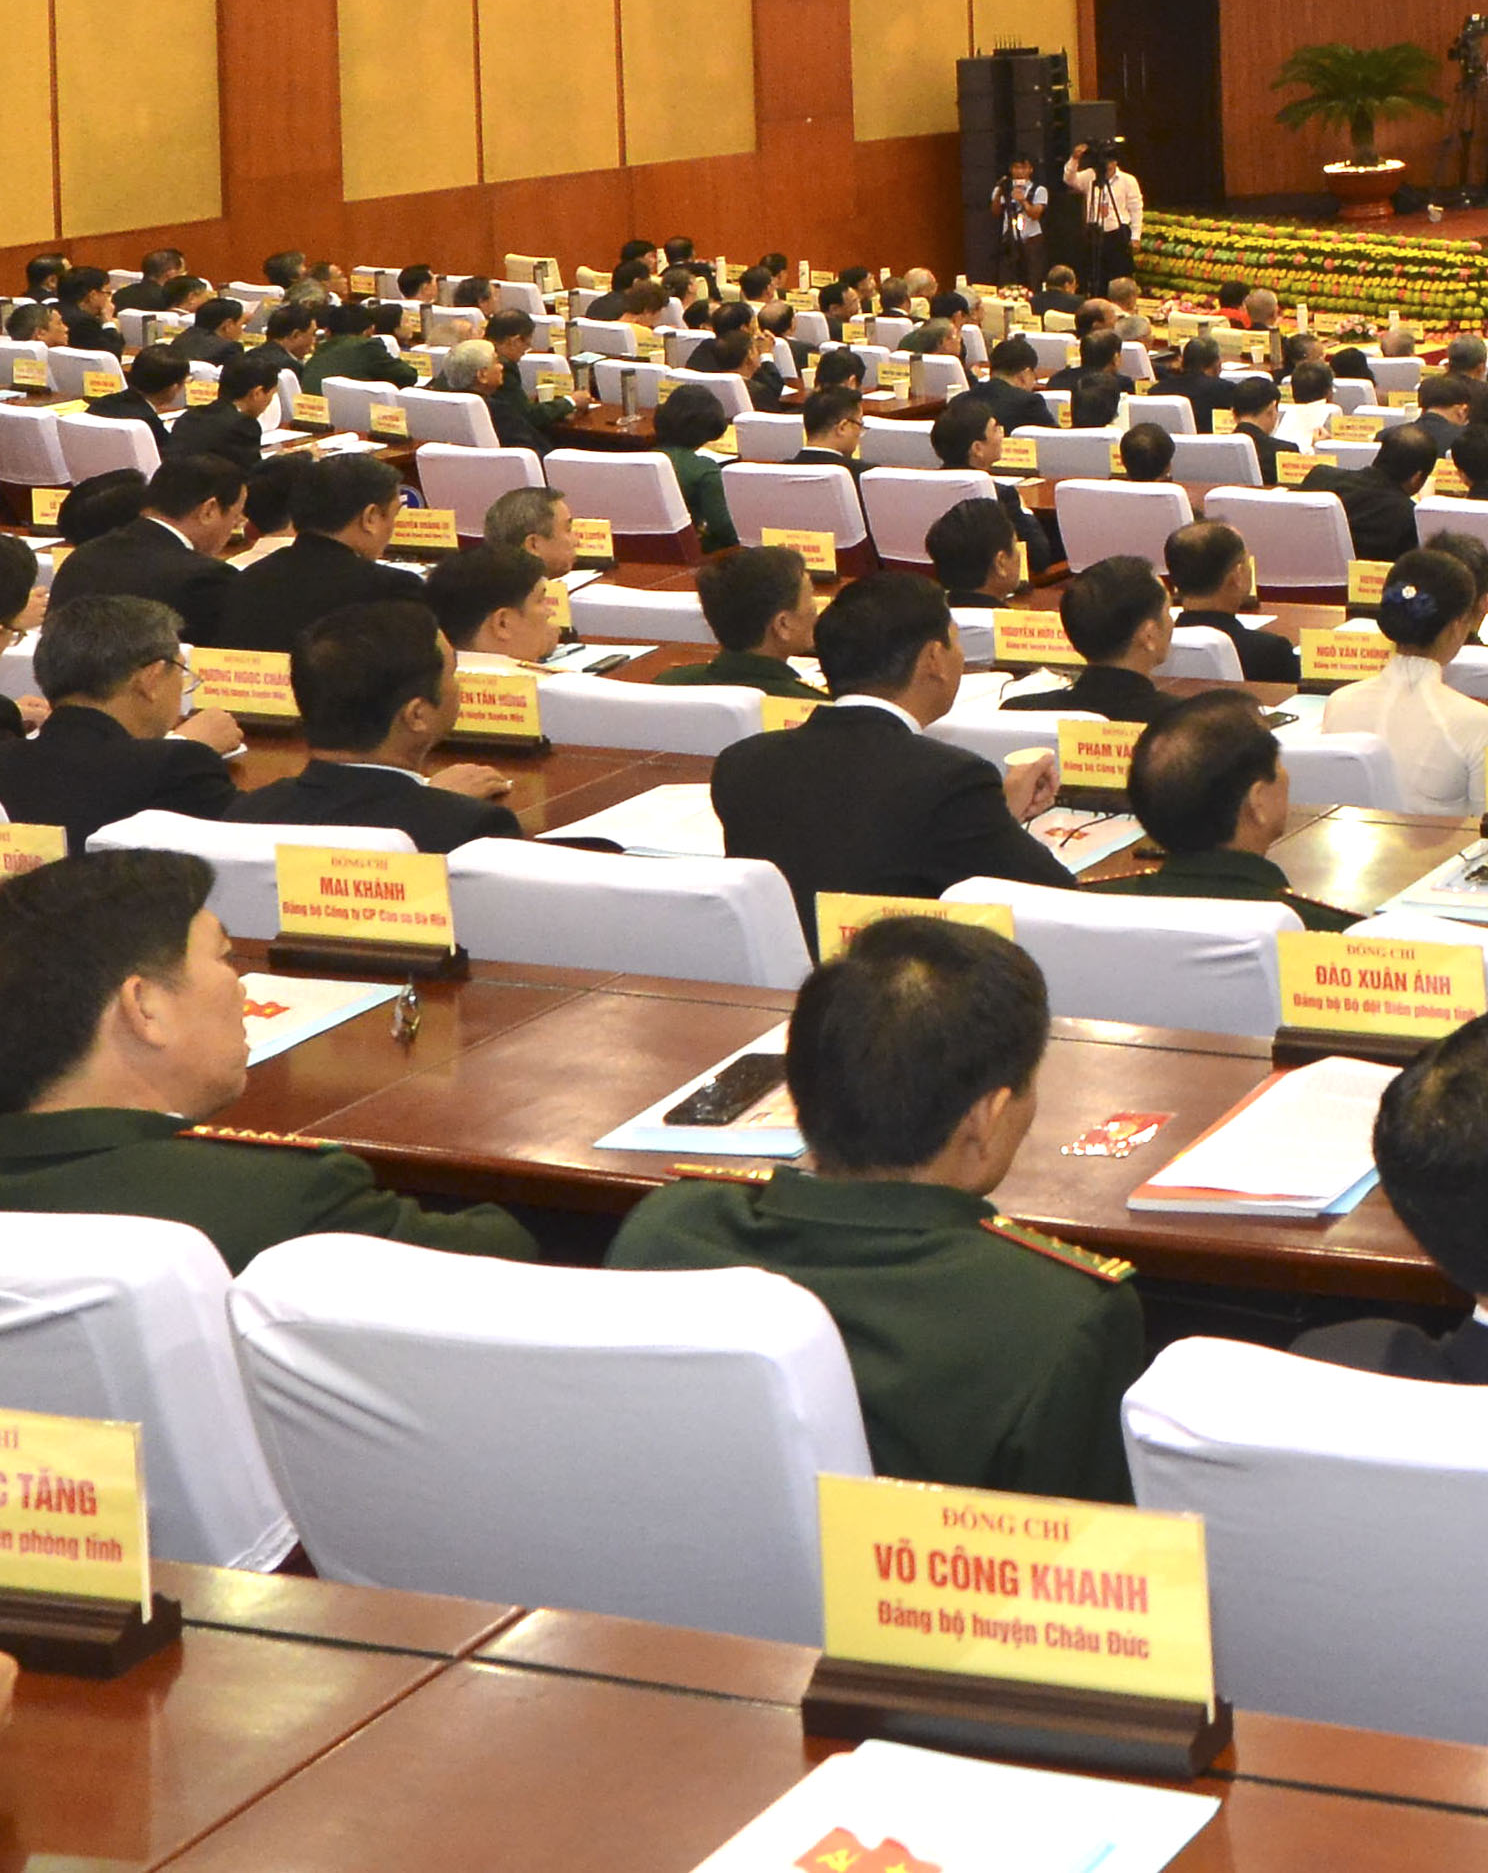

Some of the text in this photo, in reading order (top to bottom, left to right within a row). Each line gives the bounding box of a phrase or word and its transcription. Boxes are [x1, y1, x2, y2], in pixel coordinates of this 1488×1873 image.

[320, 877, 405, 901] MAI KHÁNH
[18, 1468, 99, 1517] TĂNG
[20, 1531, 123, 1562] phòng tỉnh
[875, 1539, 1147, 1613] VÕ CÔNG KHANH
[878, 1600, 1150, 1660] Đảng bộ huyện Châu Đức
